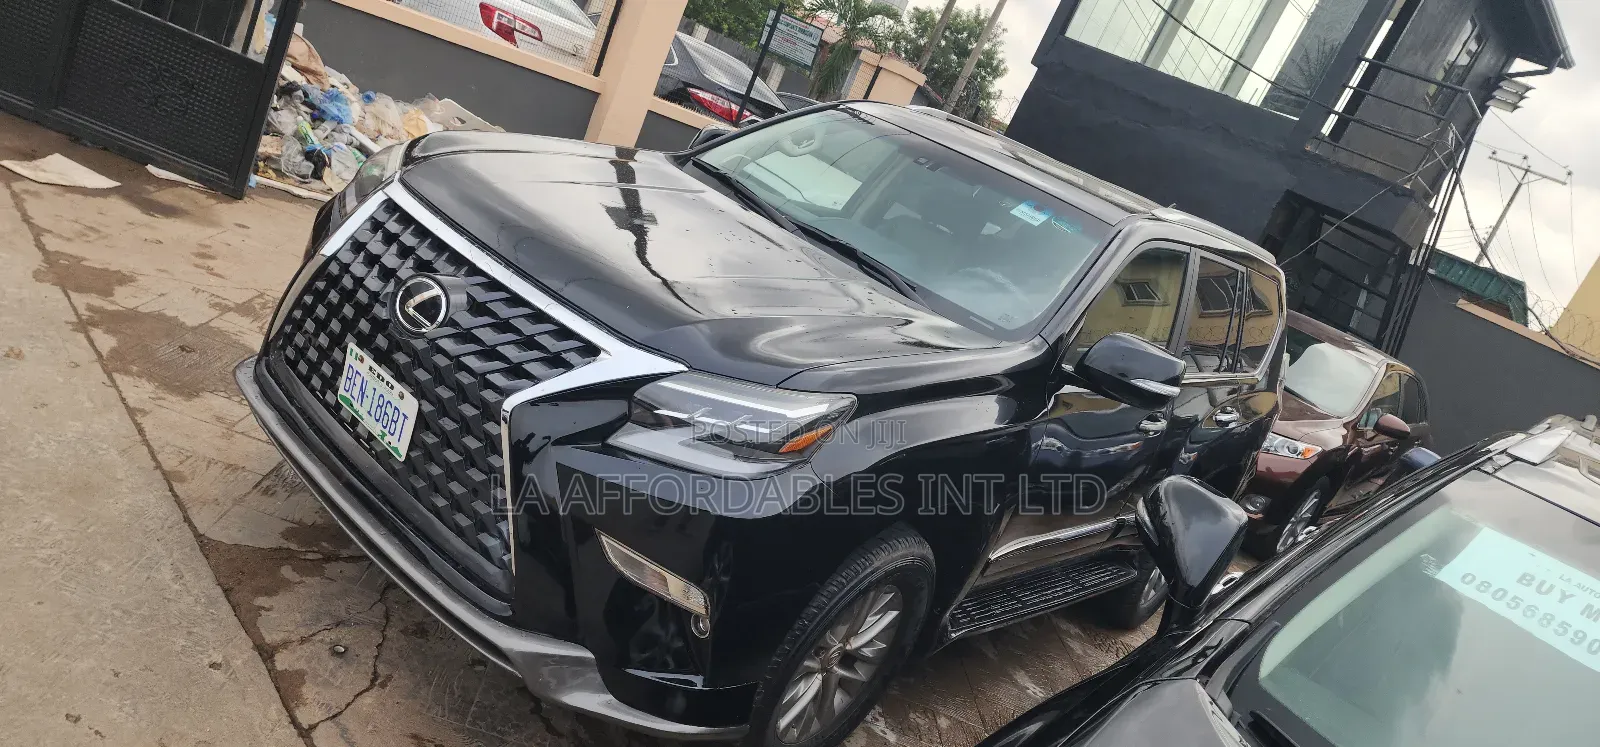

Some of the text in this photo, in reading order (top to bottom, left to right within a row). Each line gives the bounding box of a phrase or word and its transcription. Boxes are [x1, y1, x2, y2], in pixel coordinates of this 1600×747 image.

[368, 365, 395, 391] EDO
[343, 364, 409, 443] BEN-186BT
[1516, 572, 1576, 605] BUY
